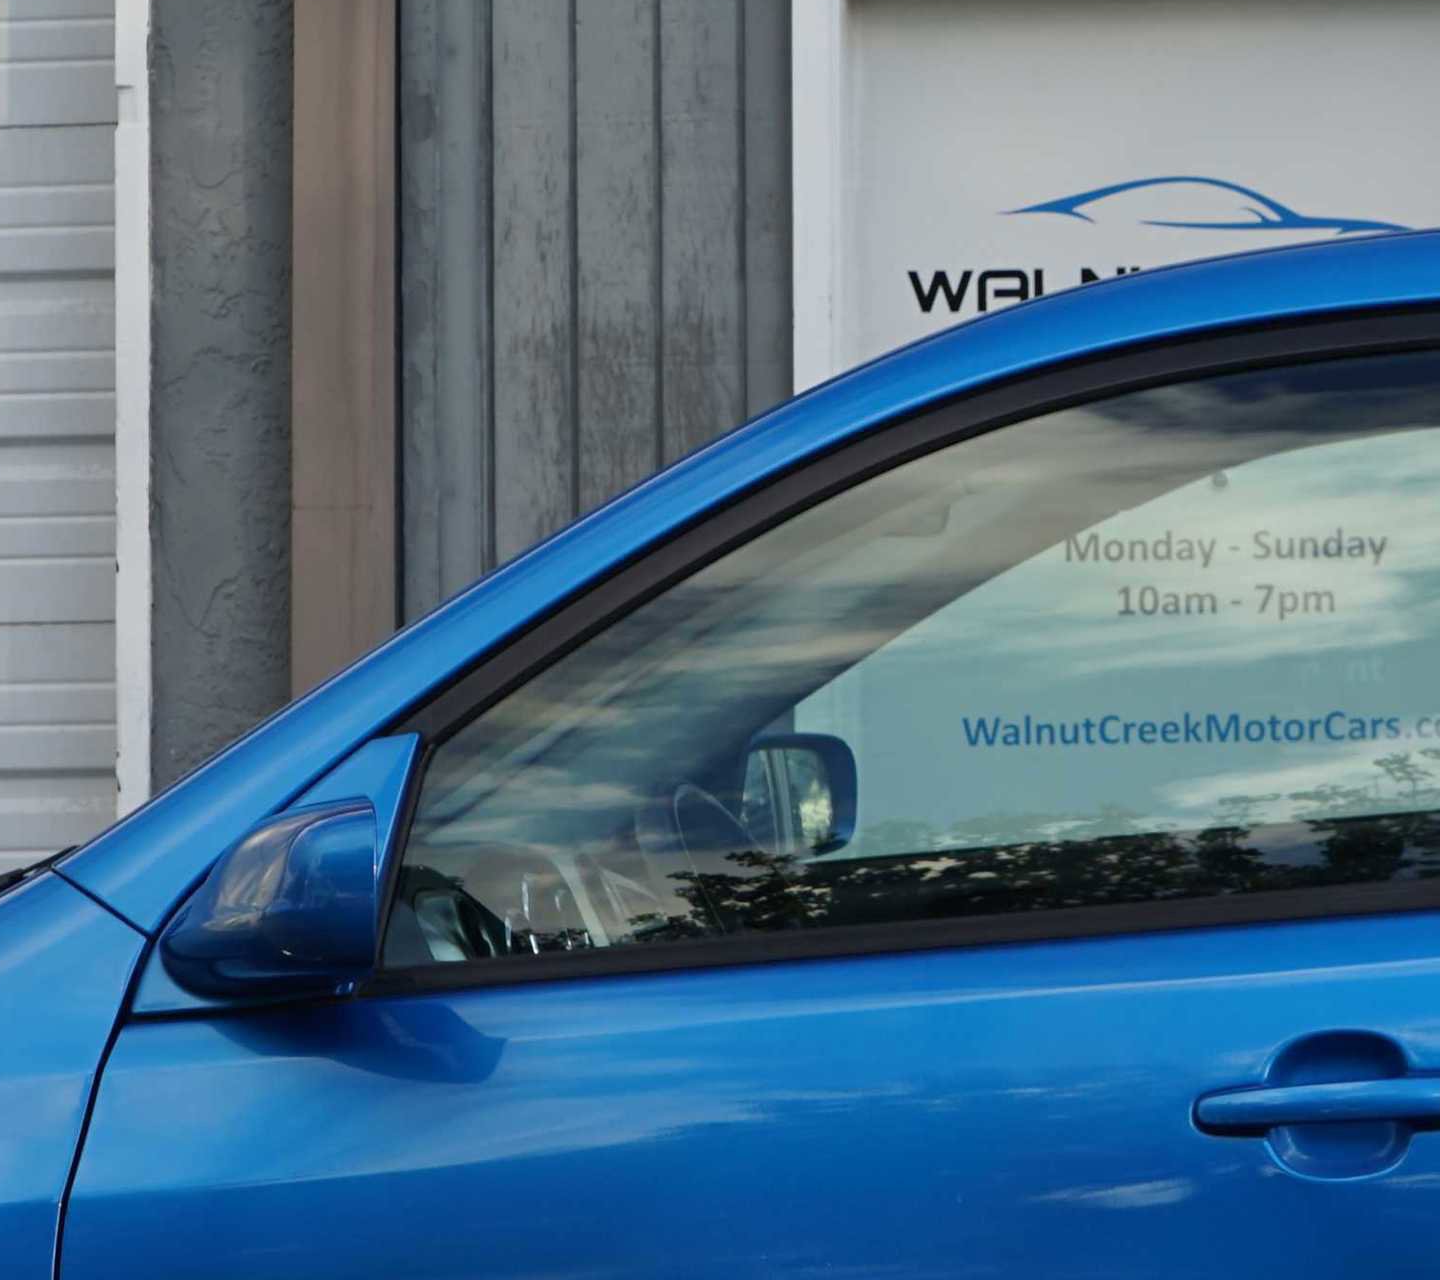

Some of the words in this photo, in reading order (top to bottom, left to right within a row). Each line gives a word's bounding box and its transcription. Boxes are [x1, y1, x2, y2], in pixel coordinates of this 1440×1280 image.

[1064, 530, 1217, 568] Monday
[1252, 527, 1389, 566] Sunday
[1117, 585, 1218, 616] 10am
[1254, 584, 1336, 620] 7pm
